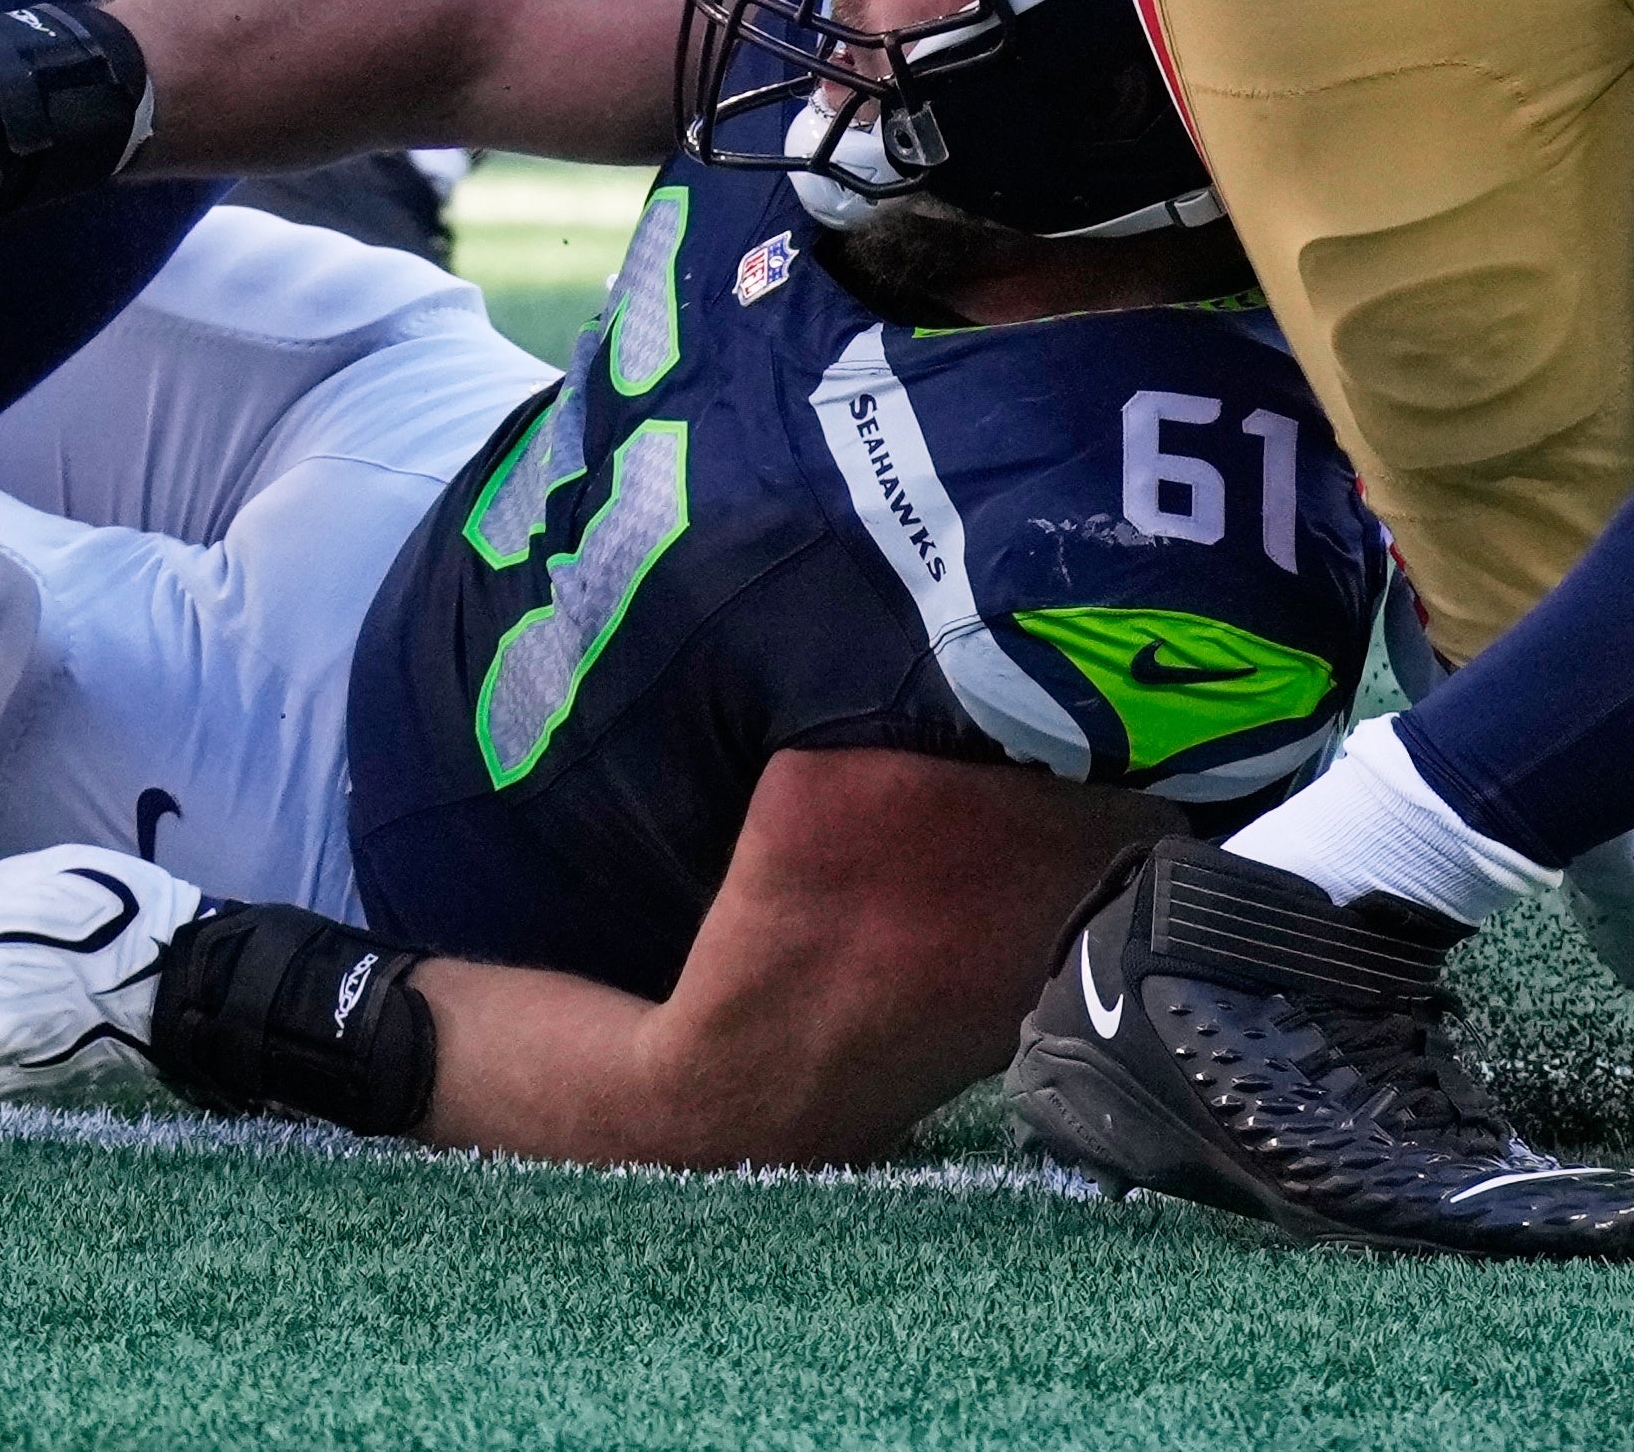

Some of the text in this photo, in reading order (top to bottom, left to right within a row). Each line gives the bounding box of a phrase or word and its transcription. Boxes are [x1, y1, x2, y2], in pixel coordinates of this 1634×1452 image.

[742, 251, 766, 295] NFL
[848, 393, 949, 584] SEAHAWKS
[1120, 390, 1300, 576] 61
